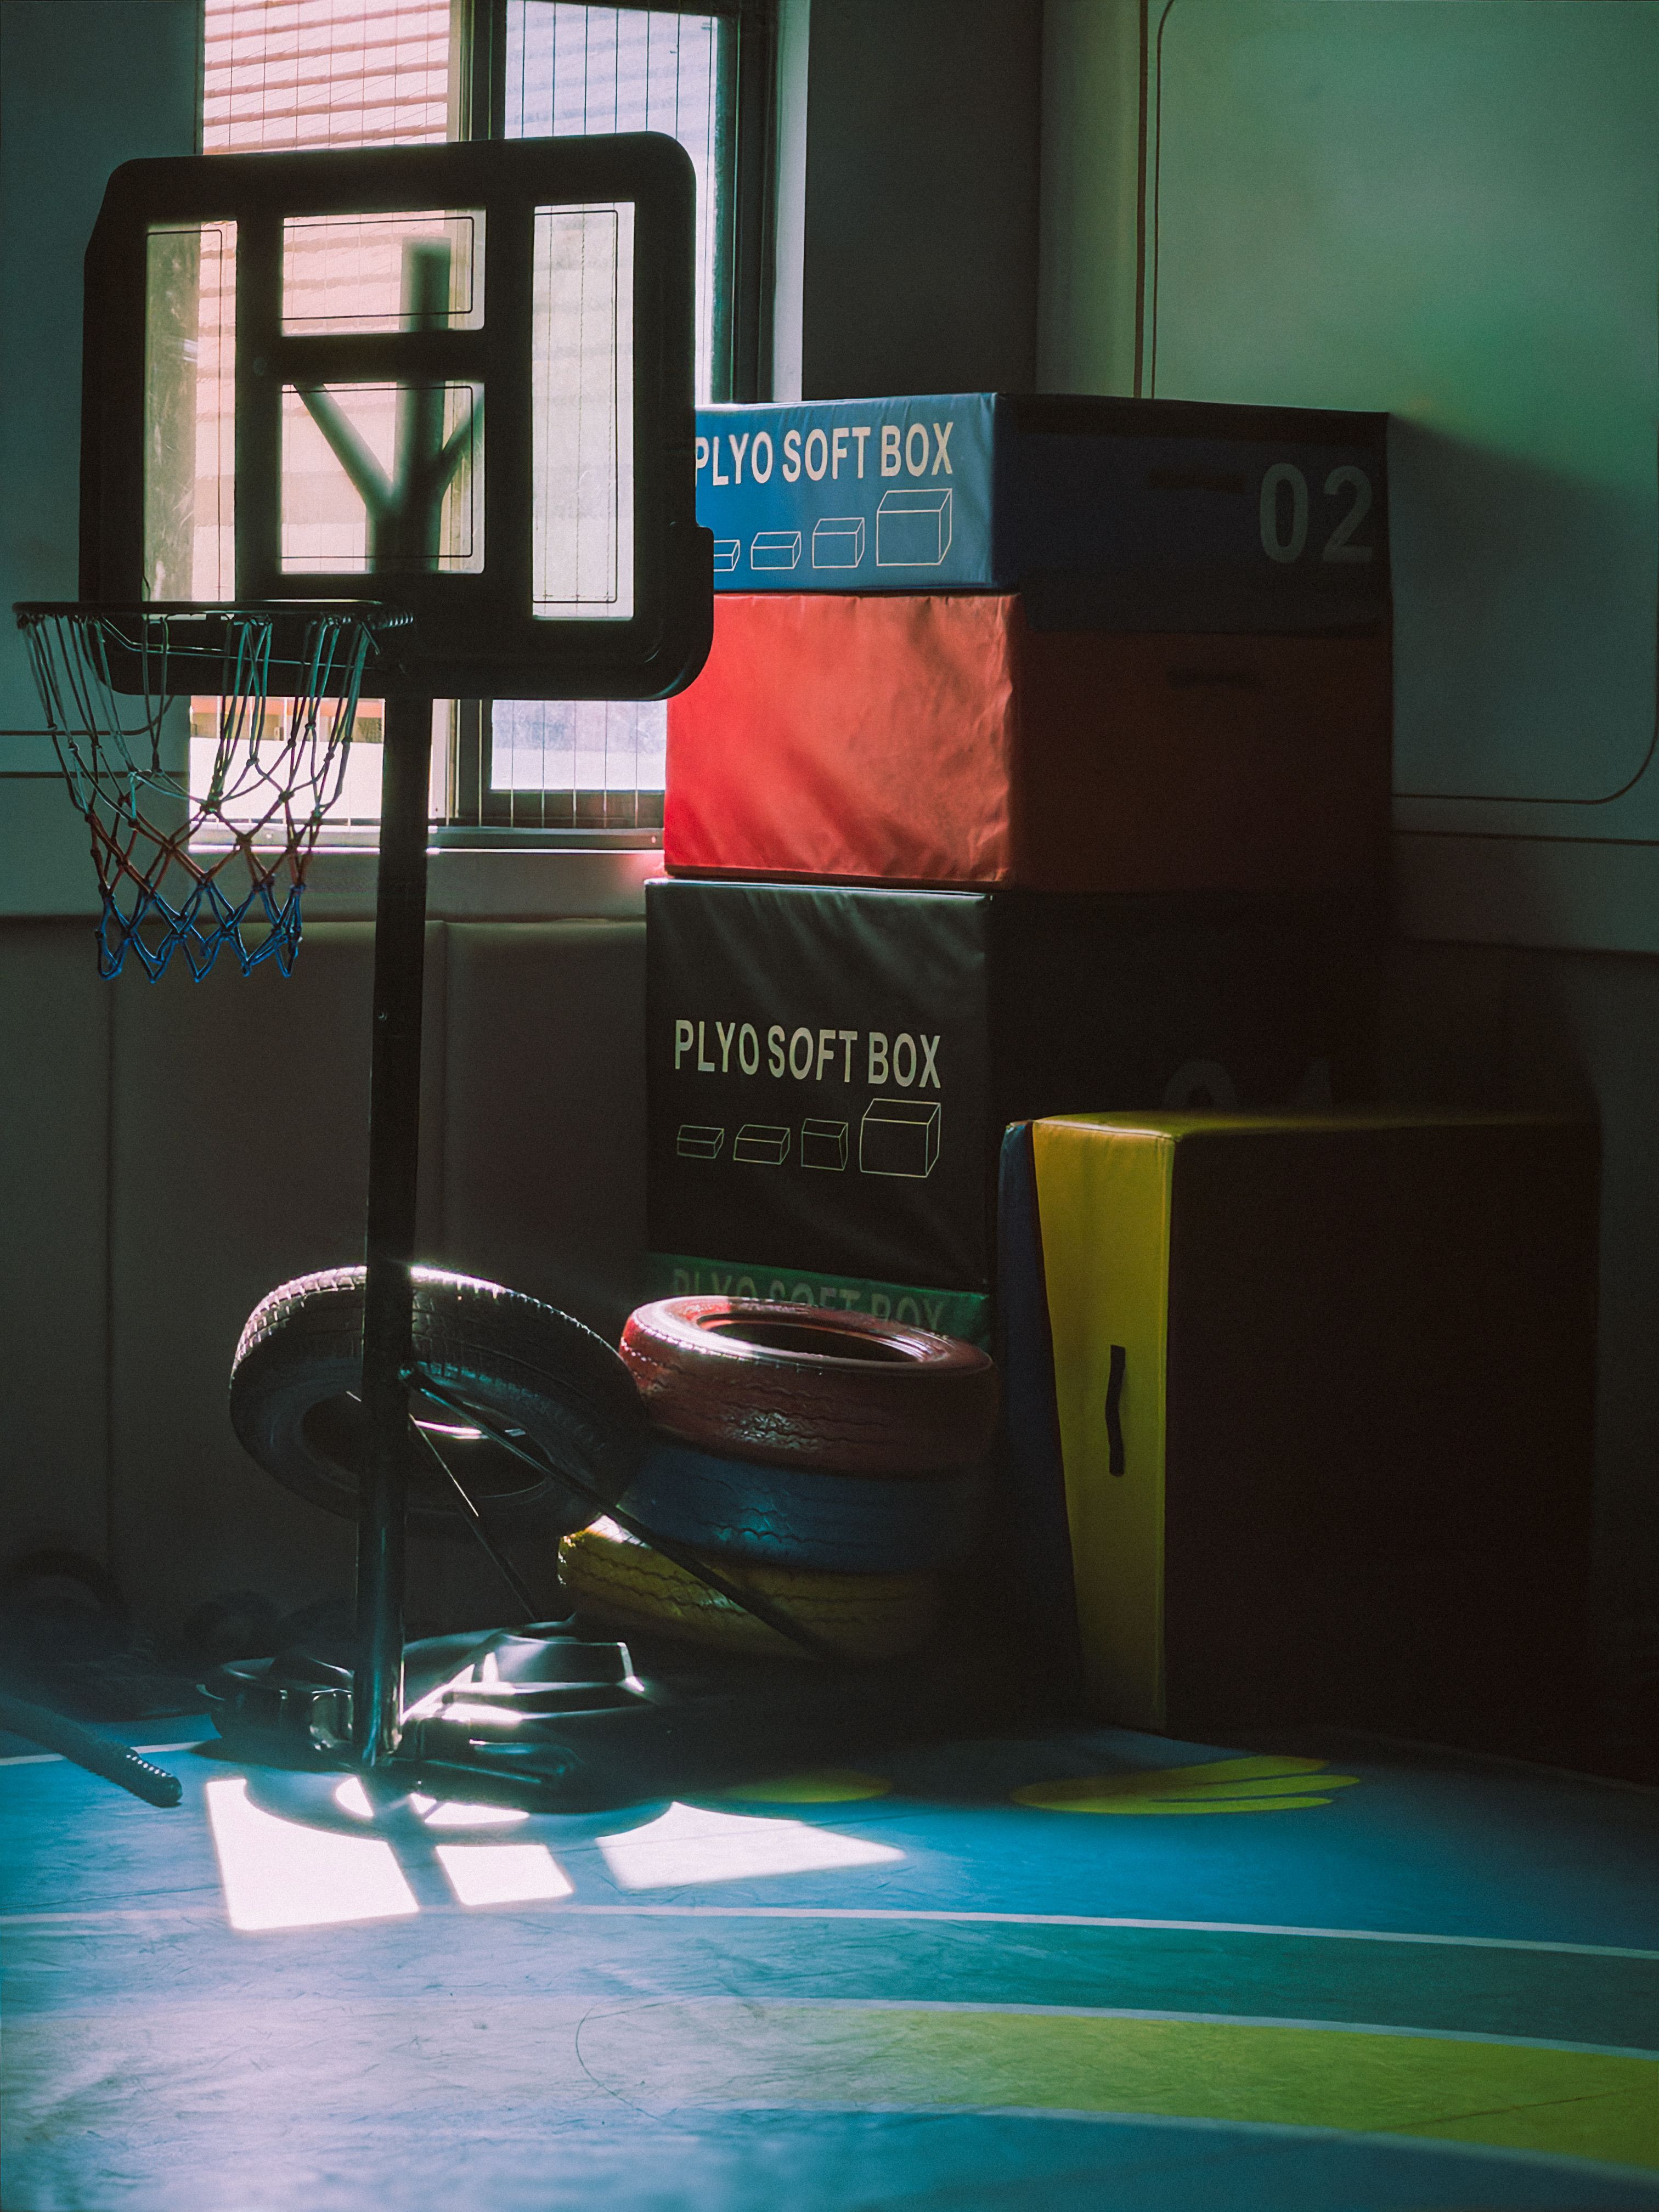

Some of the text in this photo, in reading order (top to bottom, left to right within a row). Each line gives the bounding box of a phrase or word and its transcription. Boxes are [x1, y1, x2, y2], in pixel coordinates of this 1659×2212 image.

[695, 421, 953, 487] PLYO SOFT BOX
[1260, 462, 1372, 563] 02
[674, 1019, 941, 1088] PLYO SOFT BOX
